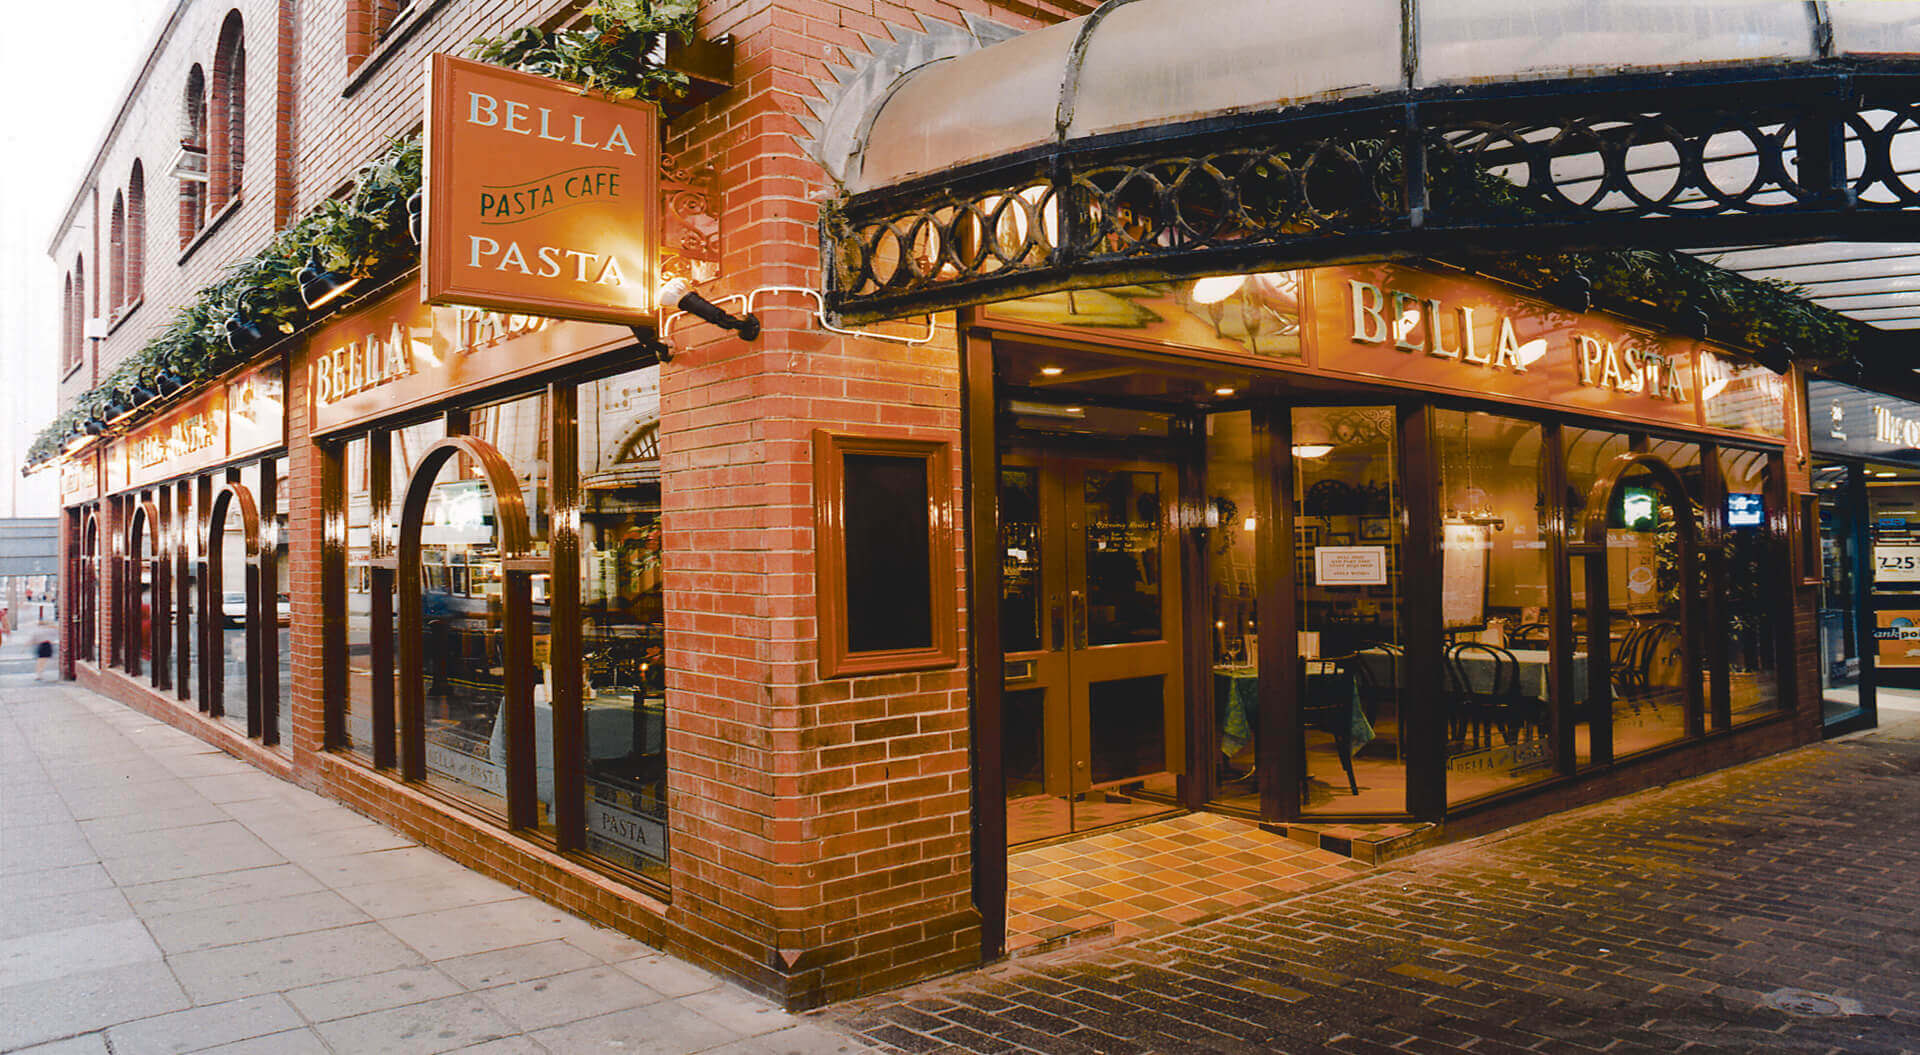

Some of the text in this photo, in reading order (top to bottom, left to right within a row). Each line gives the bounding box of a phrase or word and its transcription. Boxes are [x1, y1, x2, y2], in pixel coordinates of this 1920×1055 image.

[467, 91, 636, 156] BELLA
[480, 173, 621, 217] PASTA CAFE
[467, 234, 625, 287] PASTA
[316, 321, 412, 408] BELLA
[1349, 280, 1687, 402] BELLA PASTA
[602, 812, 647, 846] PASTA
